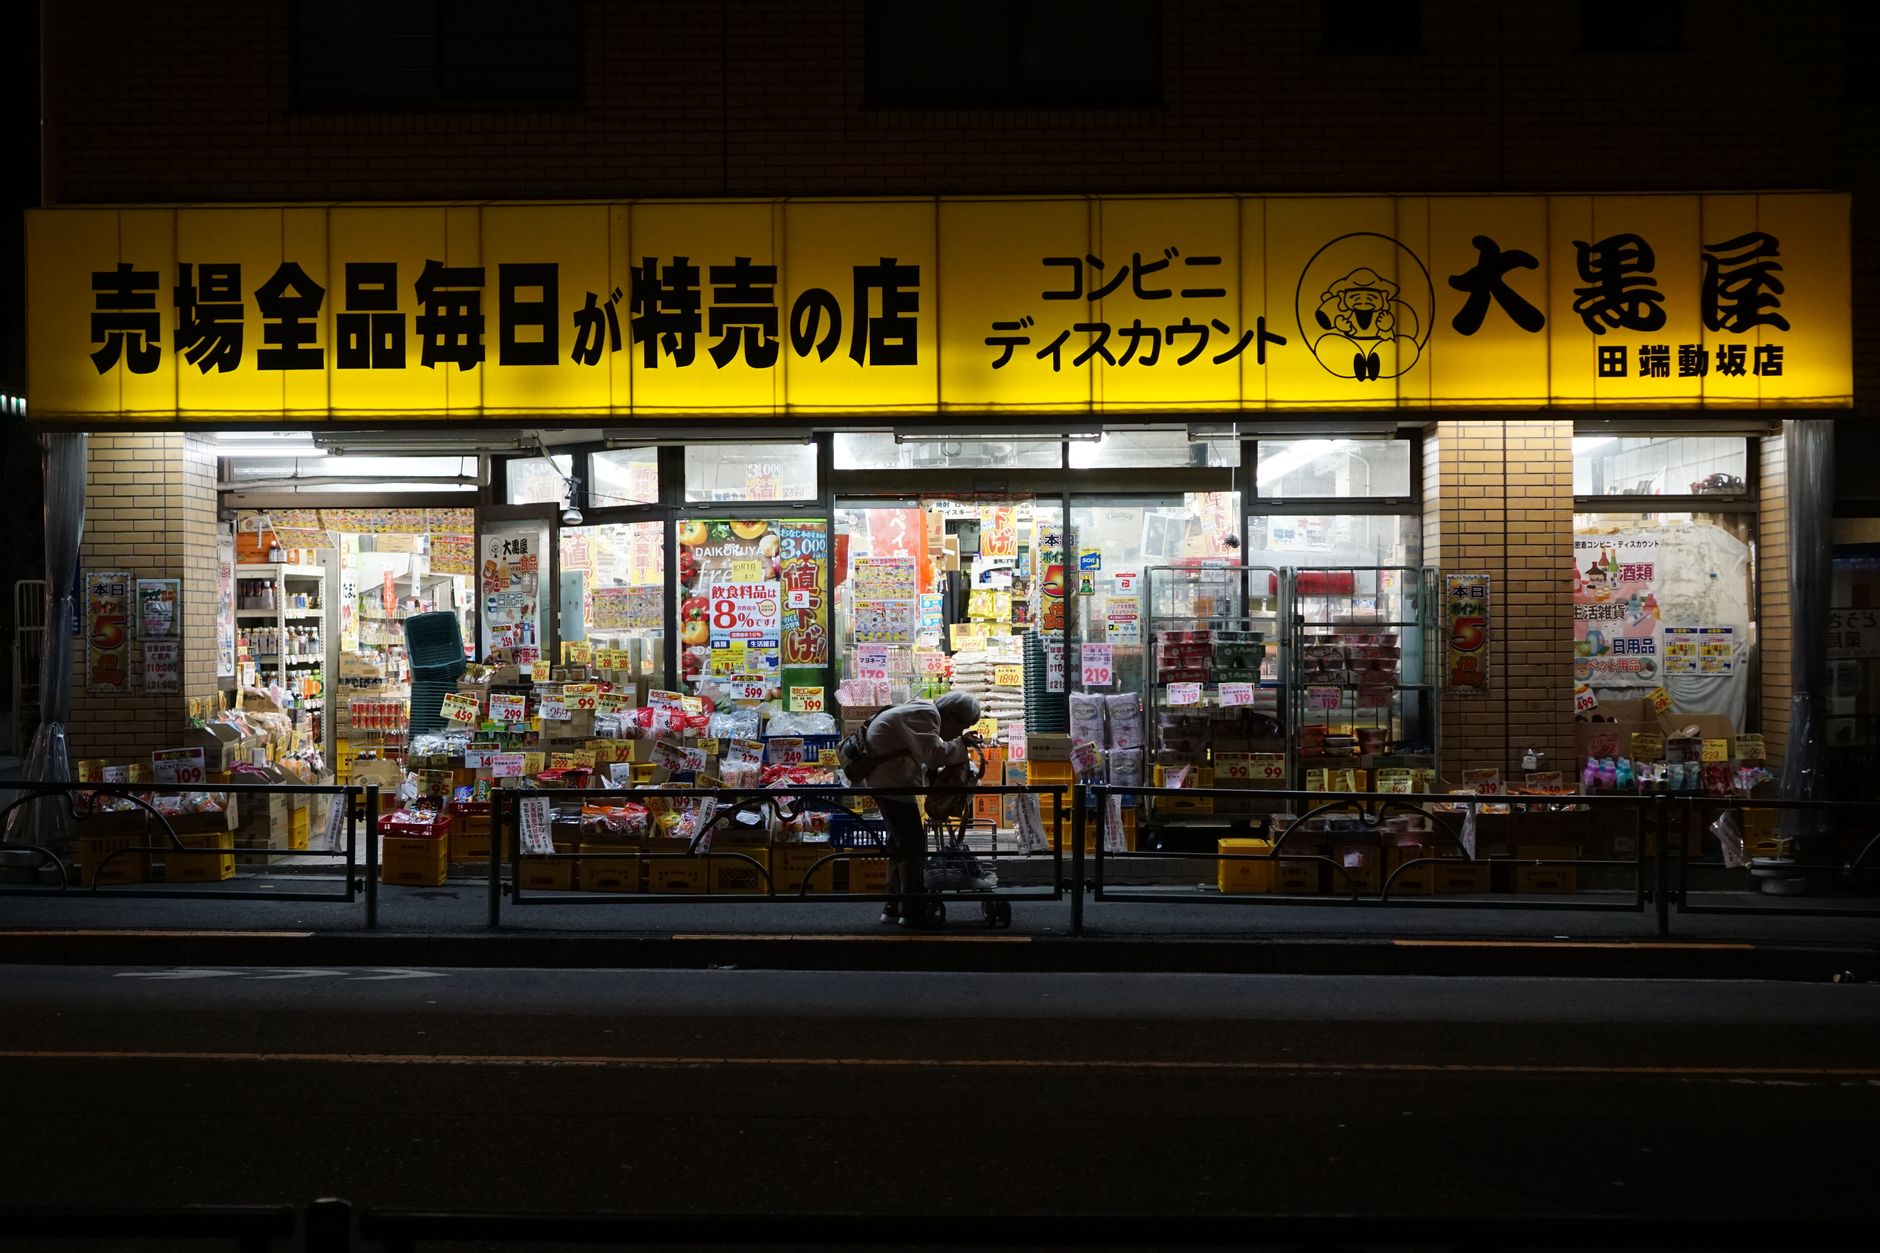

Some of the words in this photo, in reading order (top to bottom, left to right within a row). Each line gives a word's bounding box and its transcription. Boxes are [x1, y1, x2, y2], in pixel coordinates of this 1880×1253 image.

[1040, 245, 1228, 301] コンビニ
[1448, 231, 1792, 337] 大黒屋
[88, 255, 921, 375] 売場全品毎日が特売の店
[984, 315, 1288, 373] ディスカウント
[1598, 344, 1786, 379] 田端動坂店
[1618, 563, 1655, 582] 酒類
[93, 584, 125, 597] 本日
[711, 584, 777, 599] 飲食料品は
[1452, 585, 1485, 599] 本日
[1449, 617, 1487, 653] 5
[1613, 638, 1656, 655] 日用品
[1084, 667, 1109, 682] 219
[744, 687, 763, 698] 599
[1182, 692, 1198, 703] 119
[1233, 692, 1251, 704] 119
[577, 698, 596, 709] 99
[803, 700, 822, 711] 199
[1321, 698, 1339, 708] 119
[1577, 696, 1595, 711] 499
[453, 709, 473, 722] 459
[503, 708, 522, 720] 299
[783, 751, 802, 763] 249
[174, 767, 202, 783] 109
[505, 765, 522, 775] 299
[1228, 766, 1247, 777] 99
[1264, 766, 1283, 778] 99
